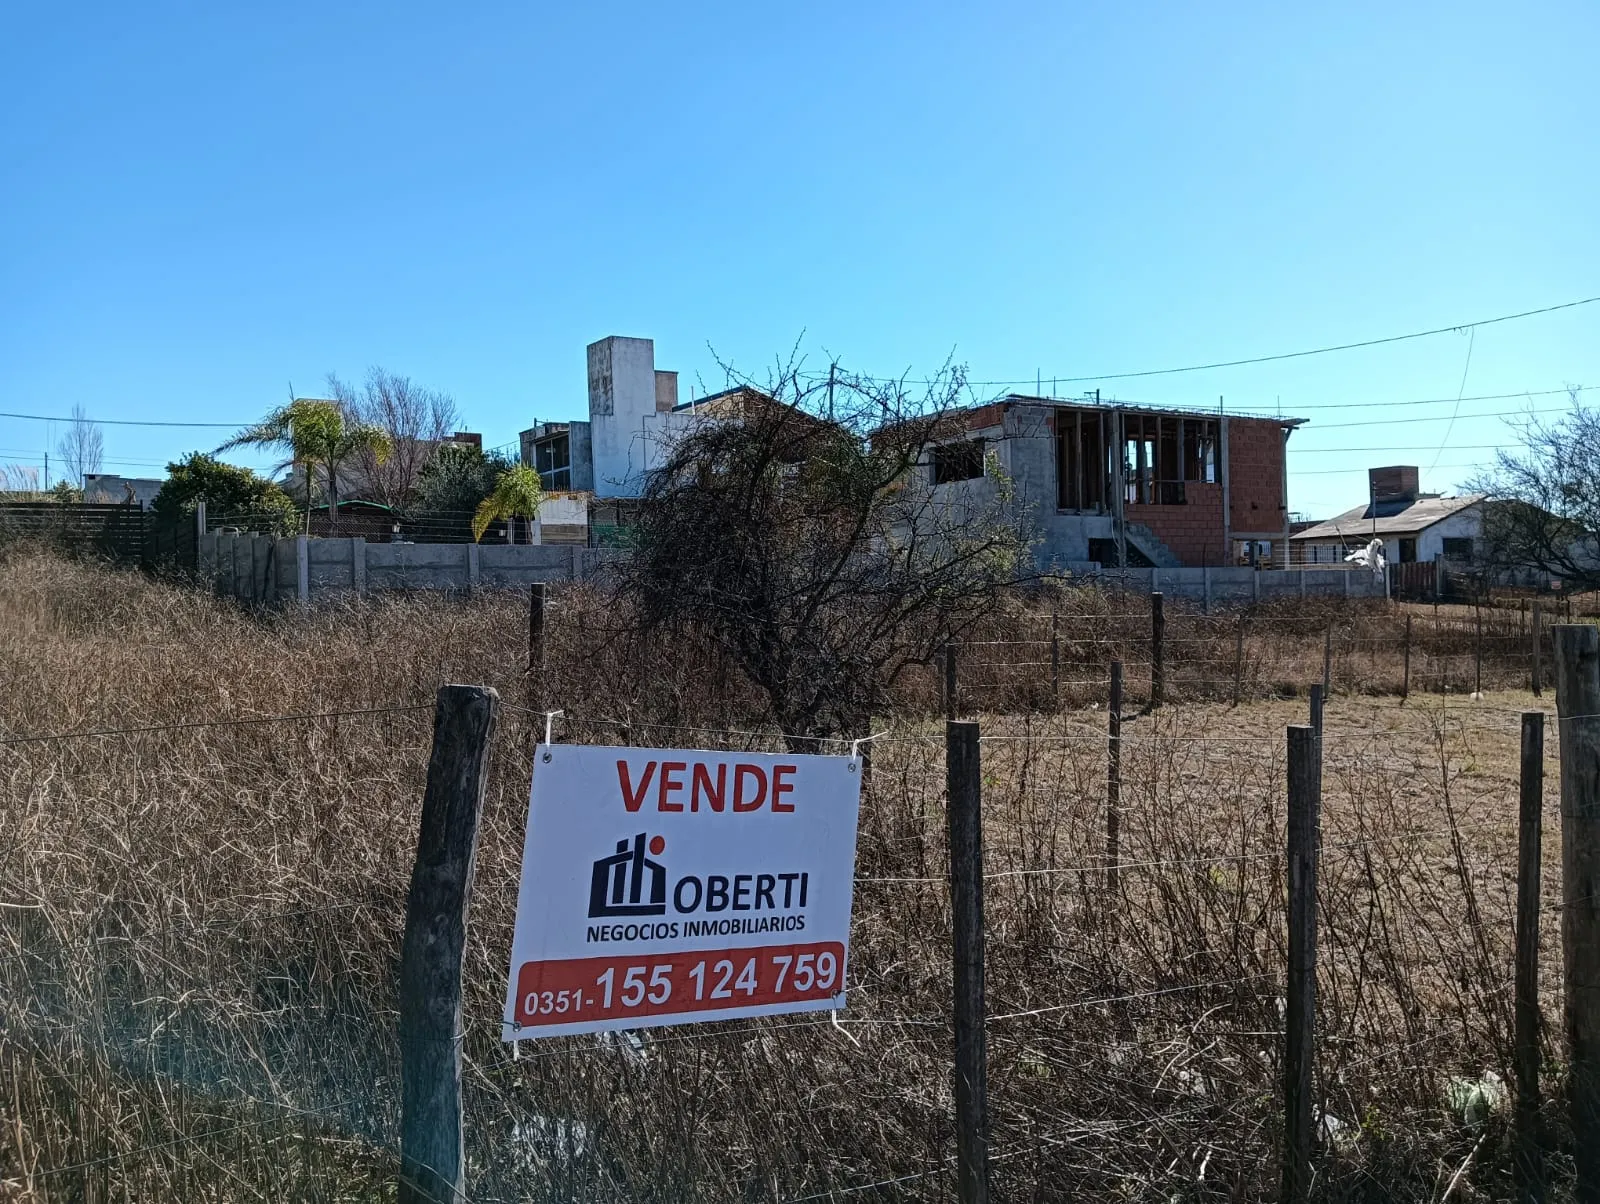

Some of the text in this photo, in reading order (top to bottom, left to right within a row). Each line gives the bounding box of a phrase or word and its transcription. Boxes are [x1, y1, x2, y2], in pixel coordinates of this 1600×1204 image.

[616, 760, 797, 813] VENDE
[586, 914, 805, 943] NEGOCIOS INMOBILIARIOS
[688, 957, 758, 1001] 124
[772, 951, 838, 992] 759
